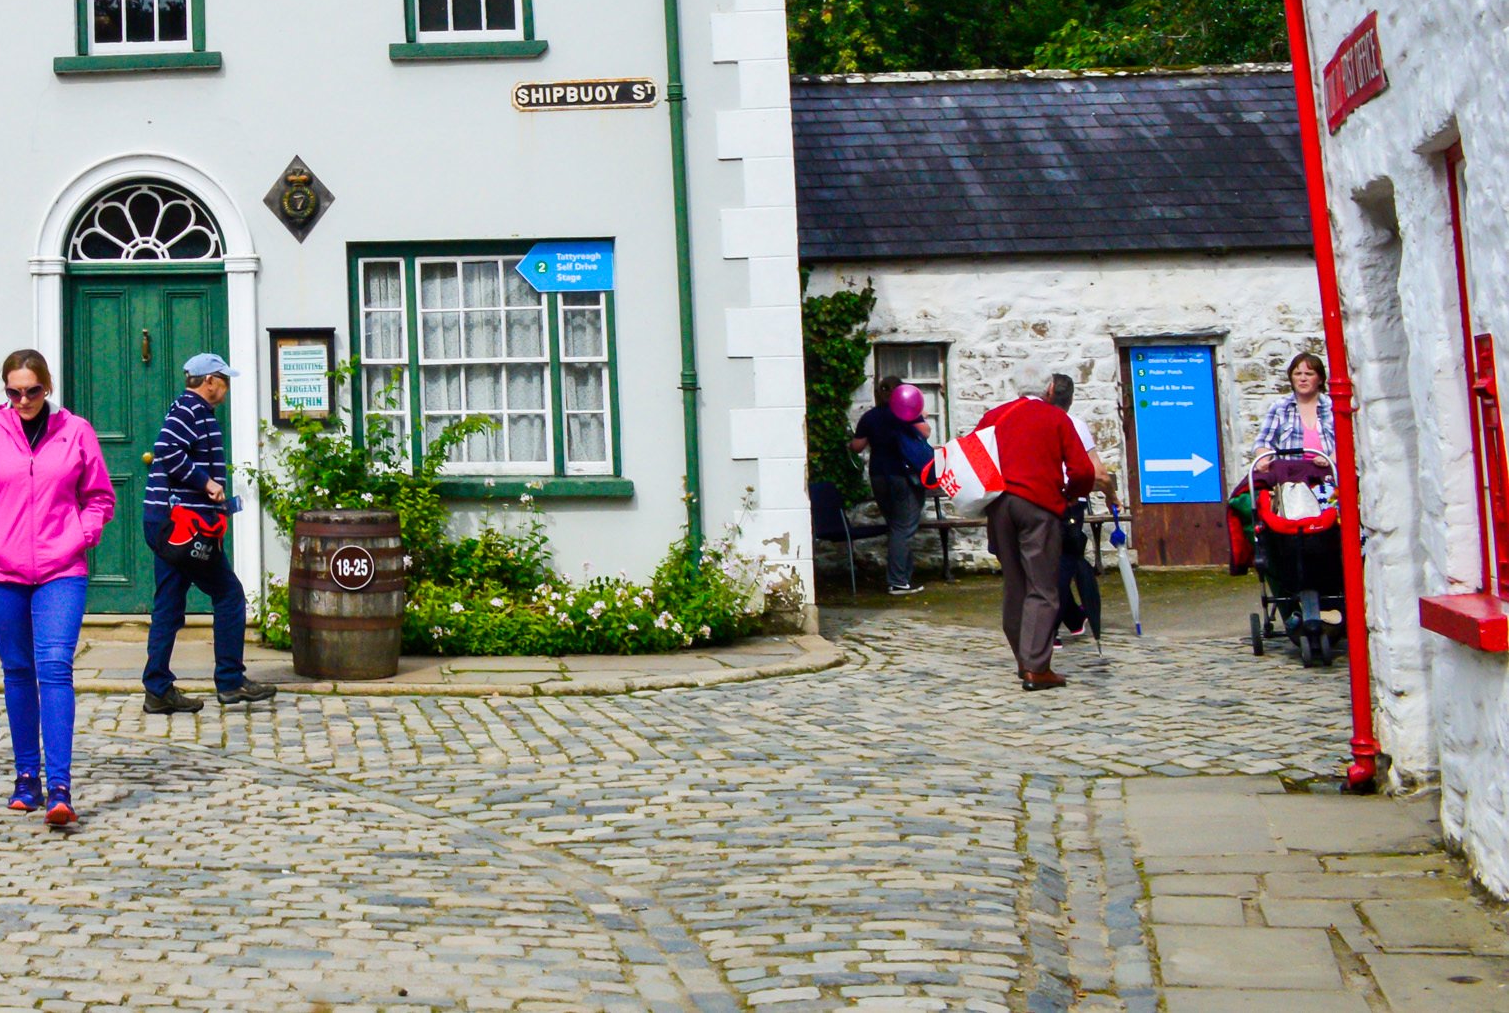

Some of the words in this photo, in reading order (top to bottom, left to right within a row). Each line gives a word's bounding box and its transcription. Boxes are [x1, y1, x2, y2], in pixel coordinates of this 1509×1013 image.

[516, 85, 620, 105] SHIPBUOY
[538, 262, 546, 273] 2
[556, 262, 573, 271] Self
[574, 262, 598, 271] Drive
[556, 273, 582, 283] Stage
[285, 384, 322, 393] SERGEANT
[336, 558, 369, 577] 18-25
